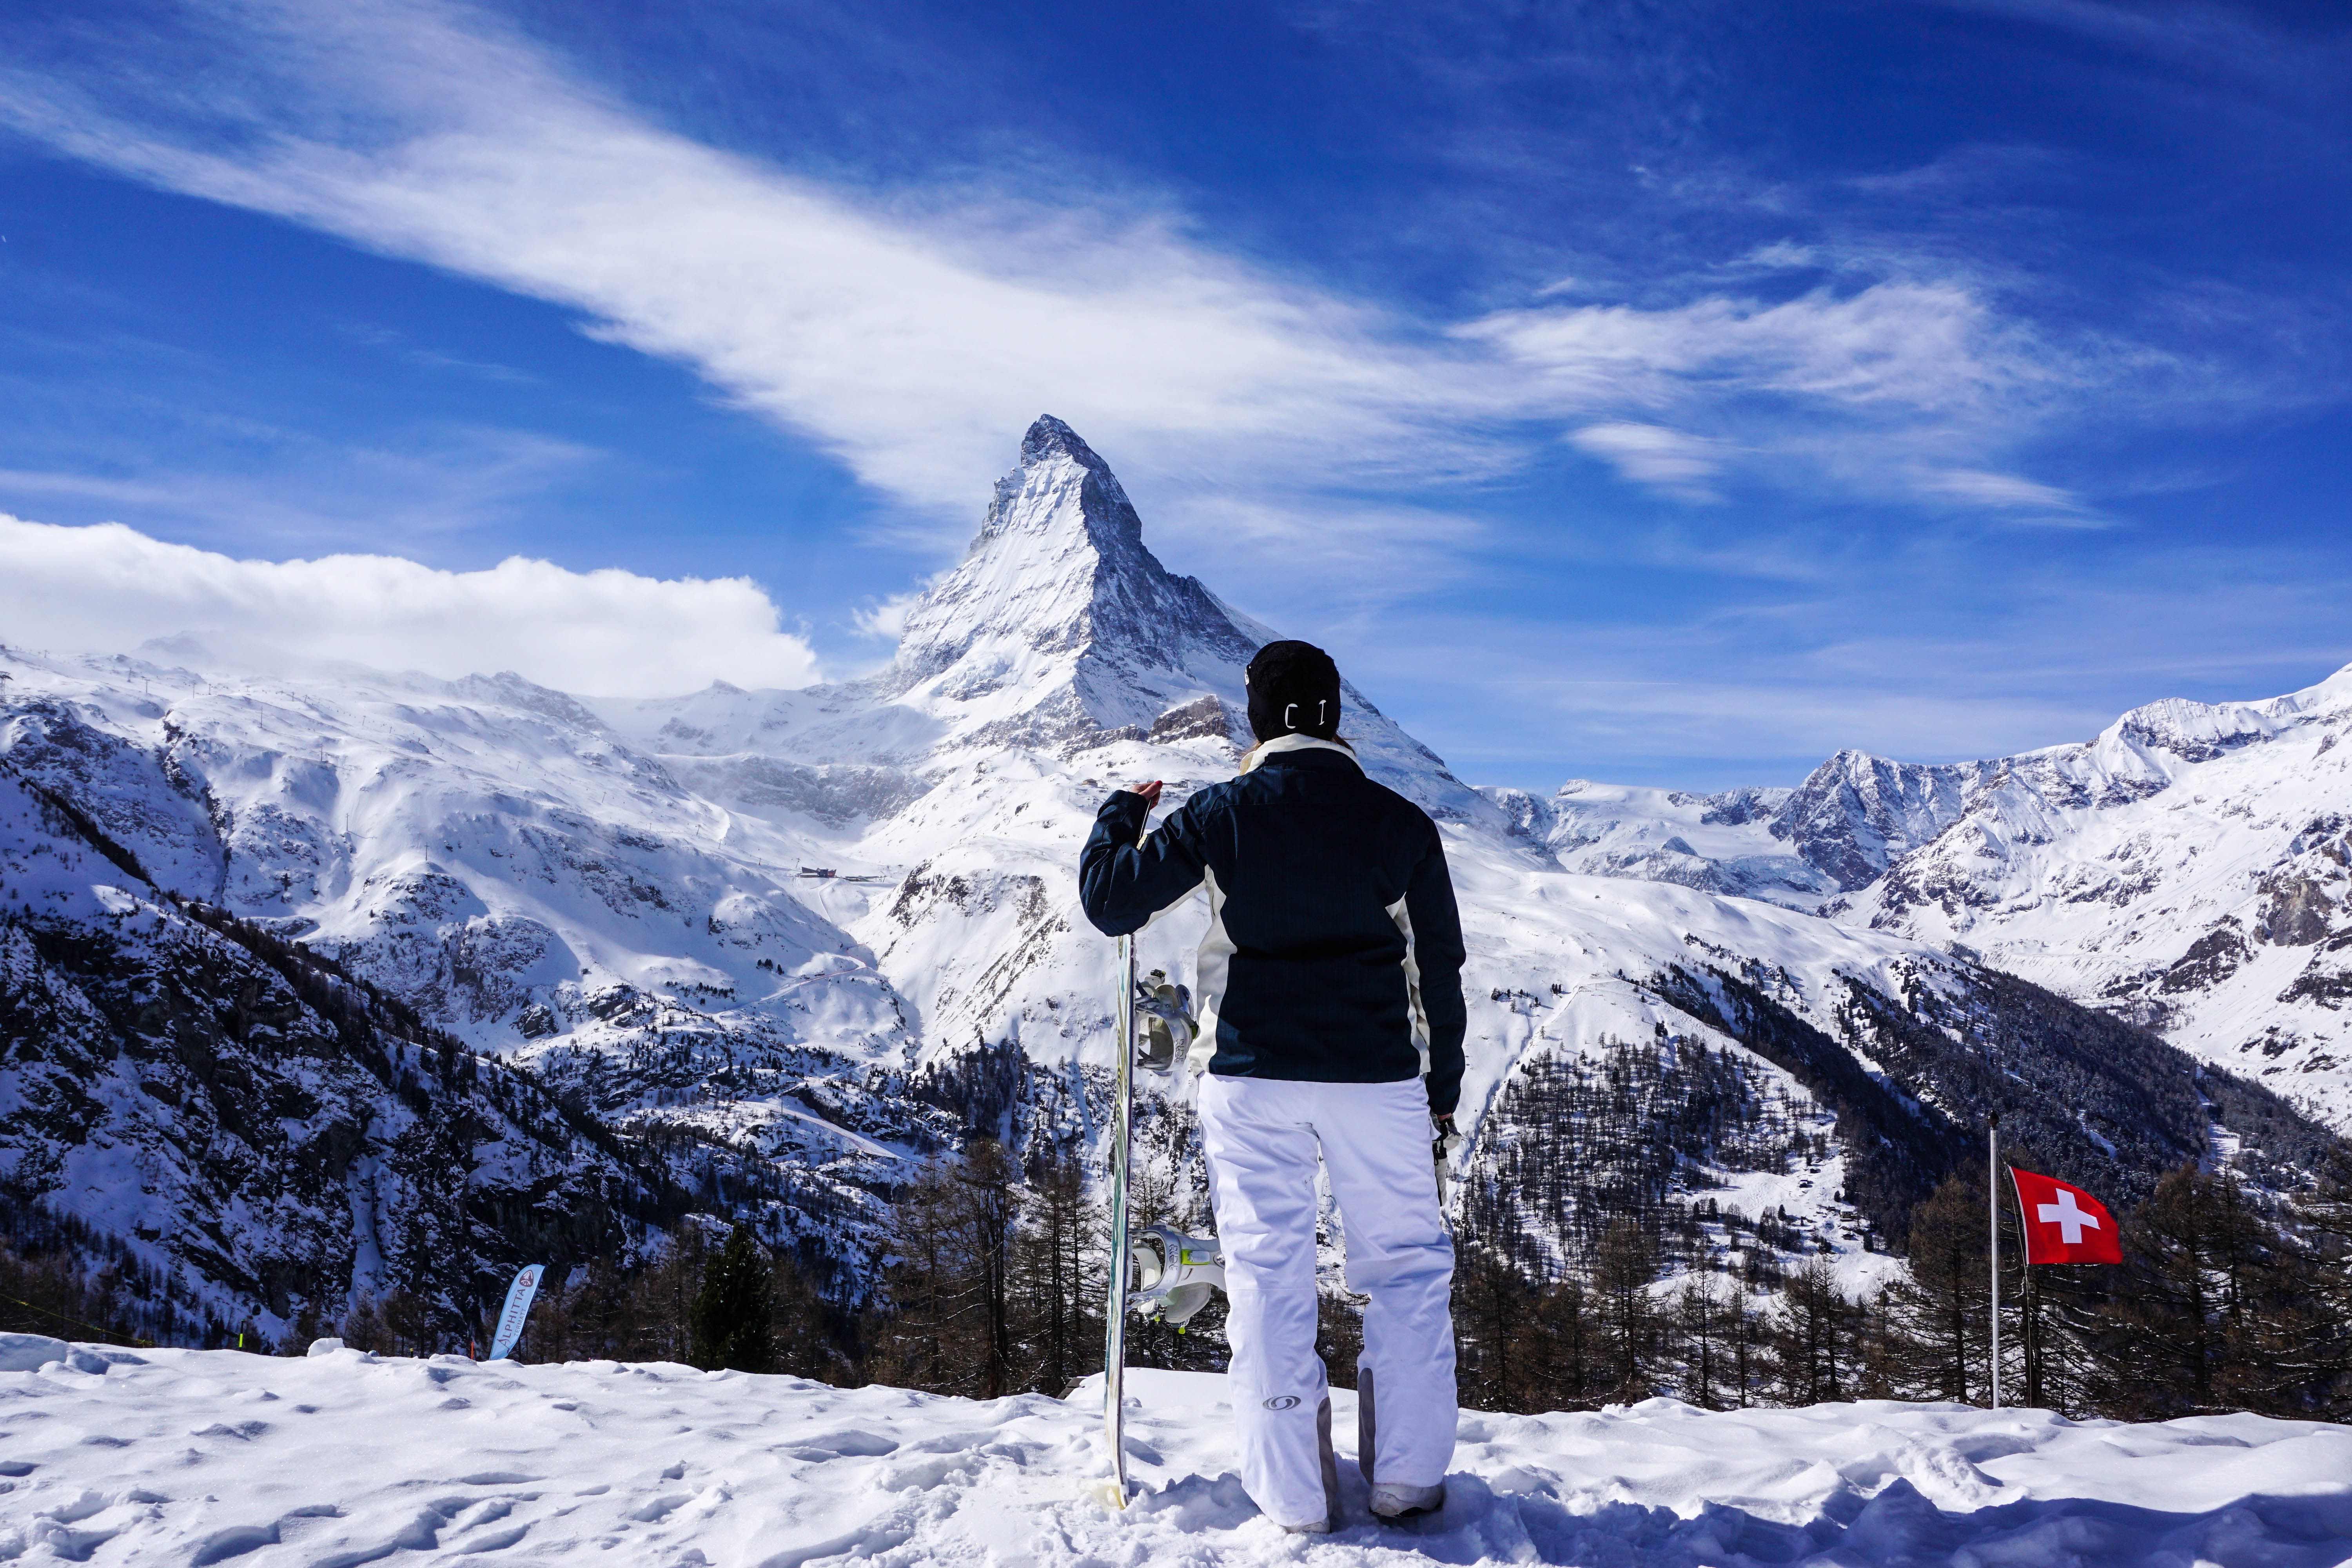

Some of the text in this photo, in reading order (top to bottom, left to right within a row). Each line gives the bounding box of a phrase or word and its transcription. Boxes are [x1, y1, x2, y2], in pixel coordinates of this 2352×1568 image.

[1174, 1038, 1184, 1063] RIDE
[1169, 1244, 1178, 1270] RIDE
[497, 1289, 526, 1353] ALPHITTA
[514, 1308, 526, 1337] ZERMATT
